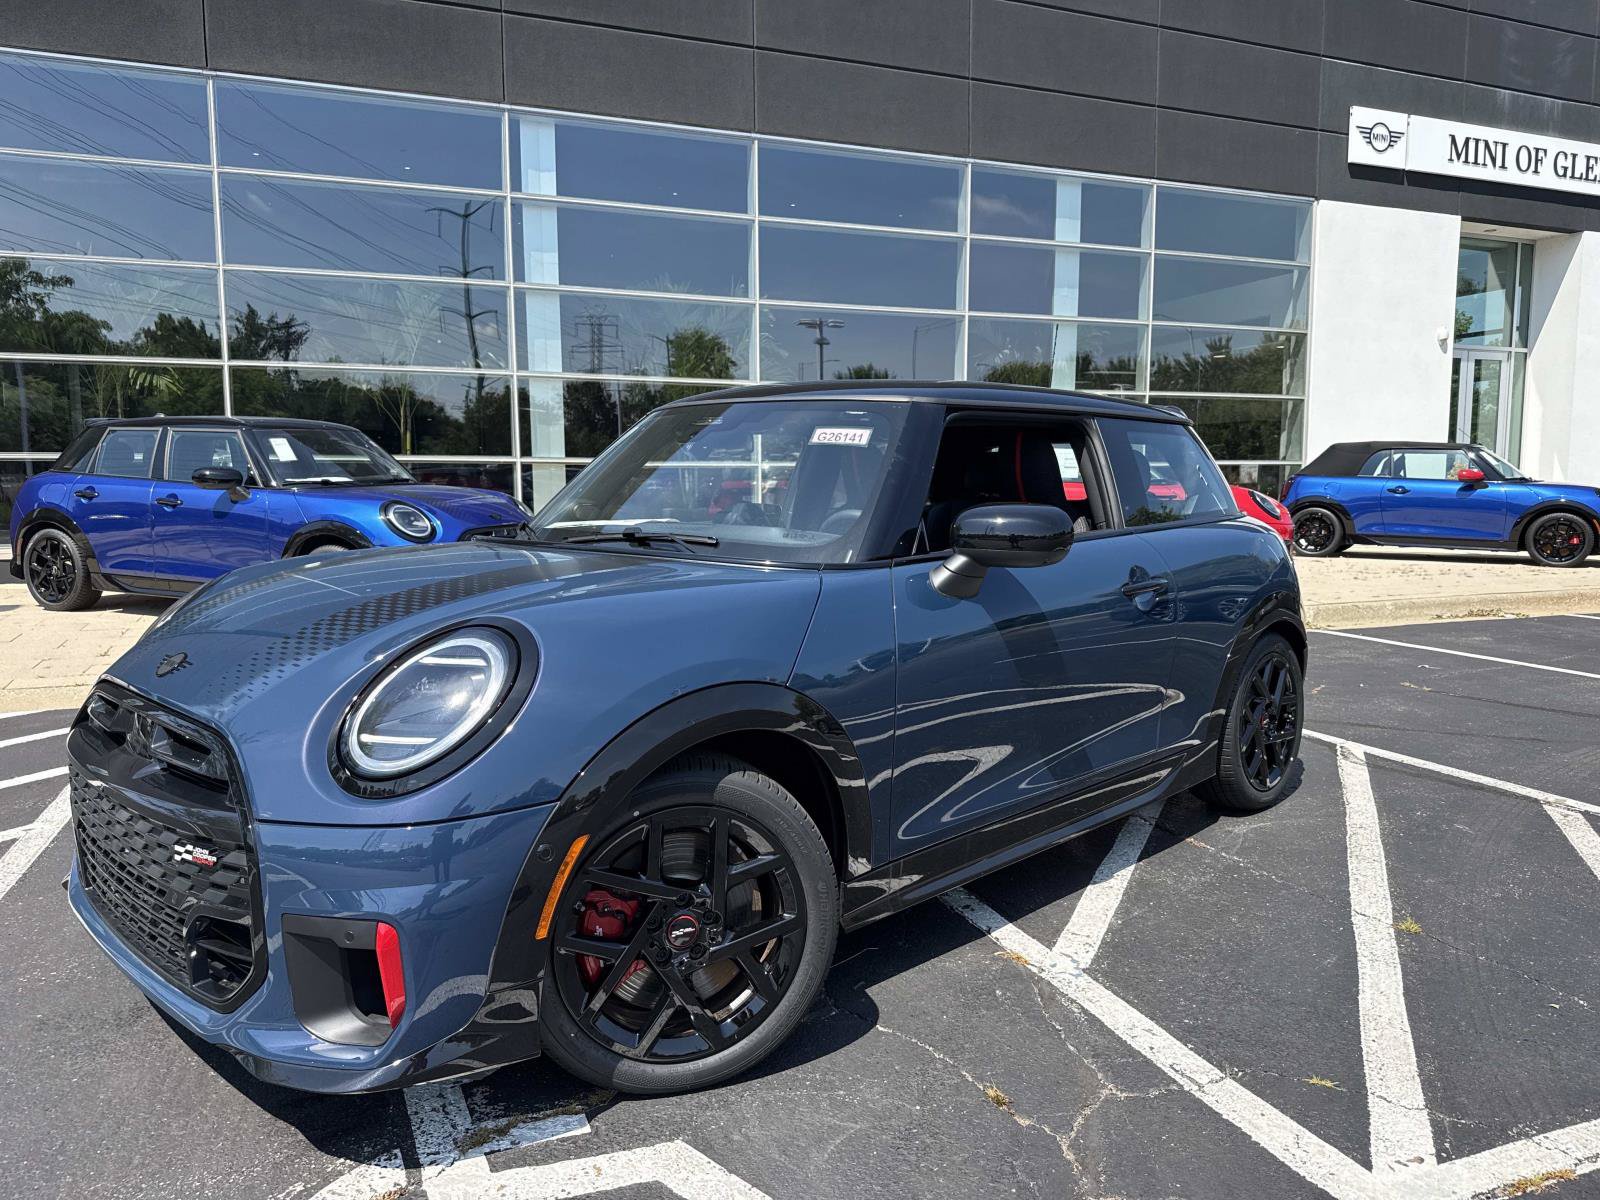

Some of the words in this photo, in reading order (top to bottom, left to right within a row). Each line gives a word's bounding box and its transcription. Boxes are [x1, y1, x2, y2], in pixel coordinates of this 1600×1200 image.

[1372, 132, 1389, 144] MINI
[1448, 134, 1509, 169] MINI
[1515, 145, 1547, 175] OF
[1553, 150, 1600, 184] GLE
[817, 432, 864, 443] G26141
[192, 851, 217, 862] COOPER
